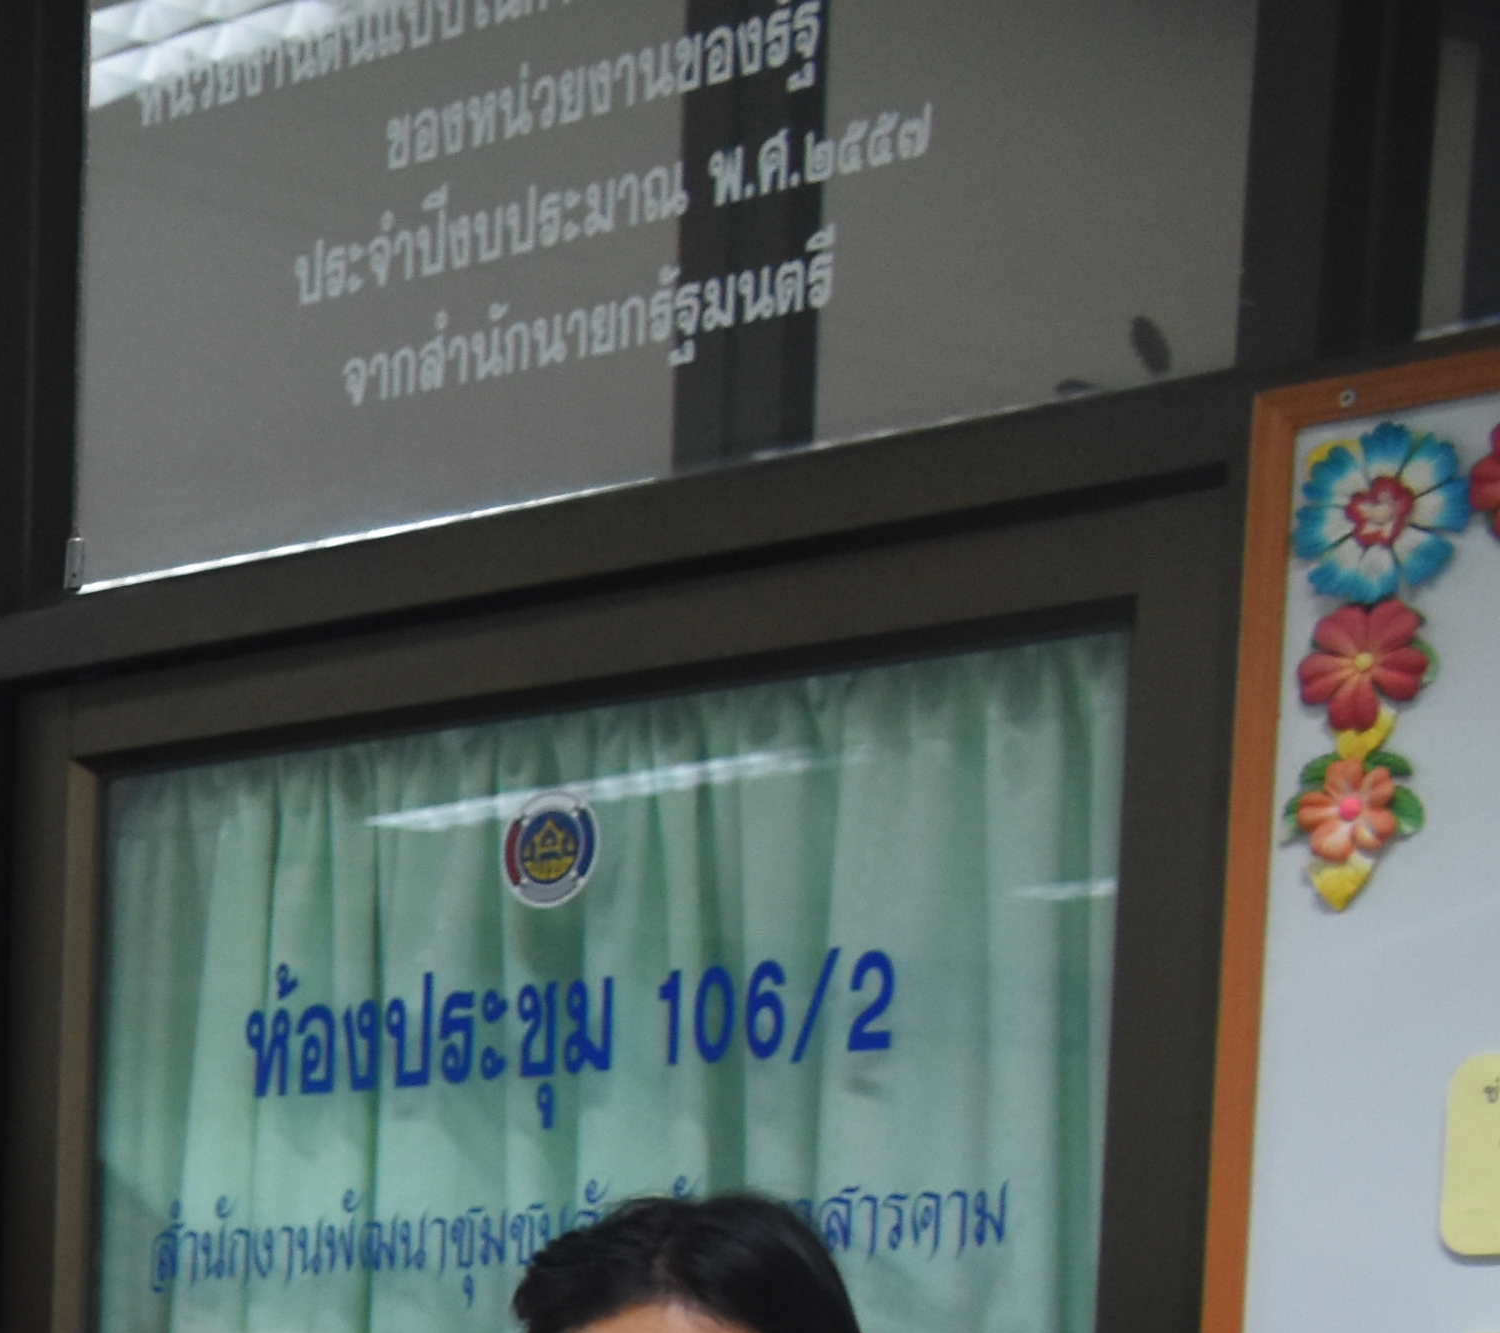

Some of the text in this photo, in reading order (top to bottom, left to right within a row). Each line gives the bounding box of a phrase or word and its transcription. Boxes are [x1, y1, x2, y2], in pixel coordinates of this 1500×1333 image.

[342, 226, 838, 407] จากสำนักนายกรัฐมนตรี
[246, 947, 896, 1129] ห้องประชุม 106/2
